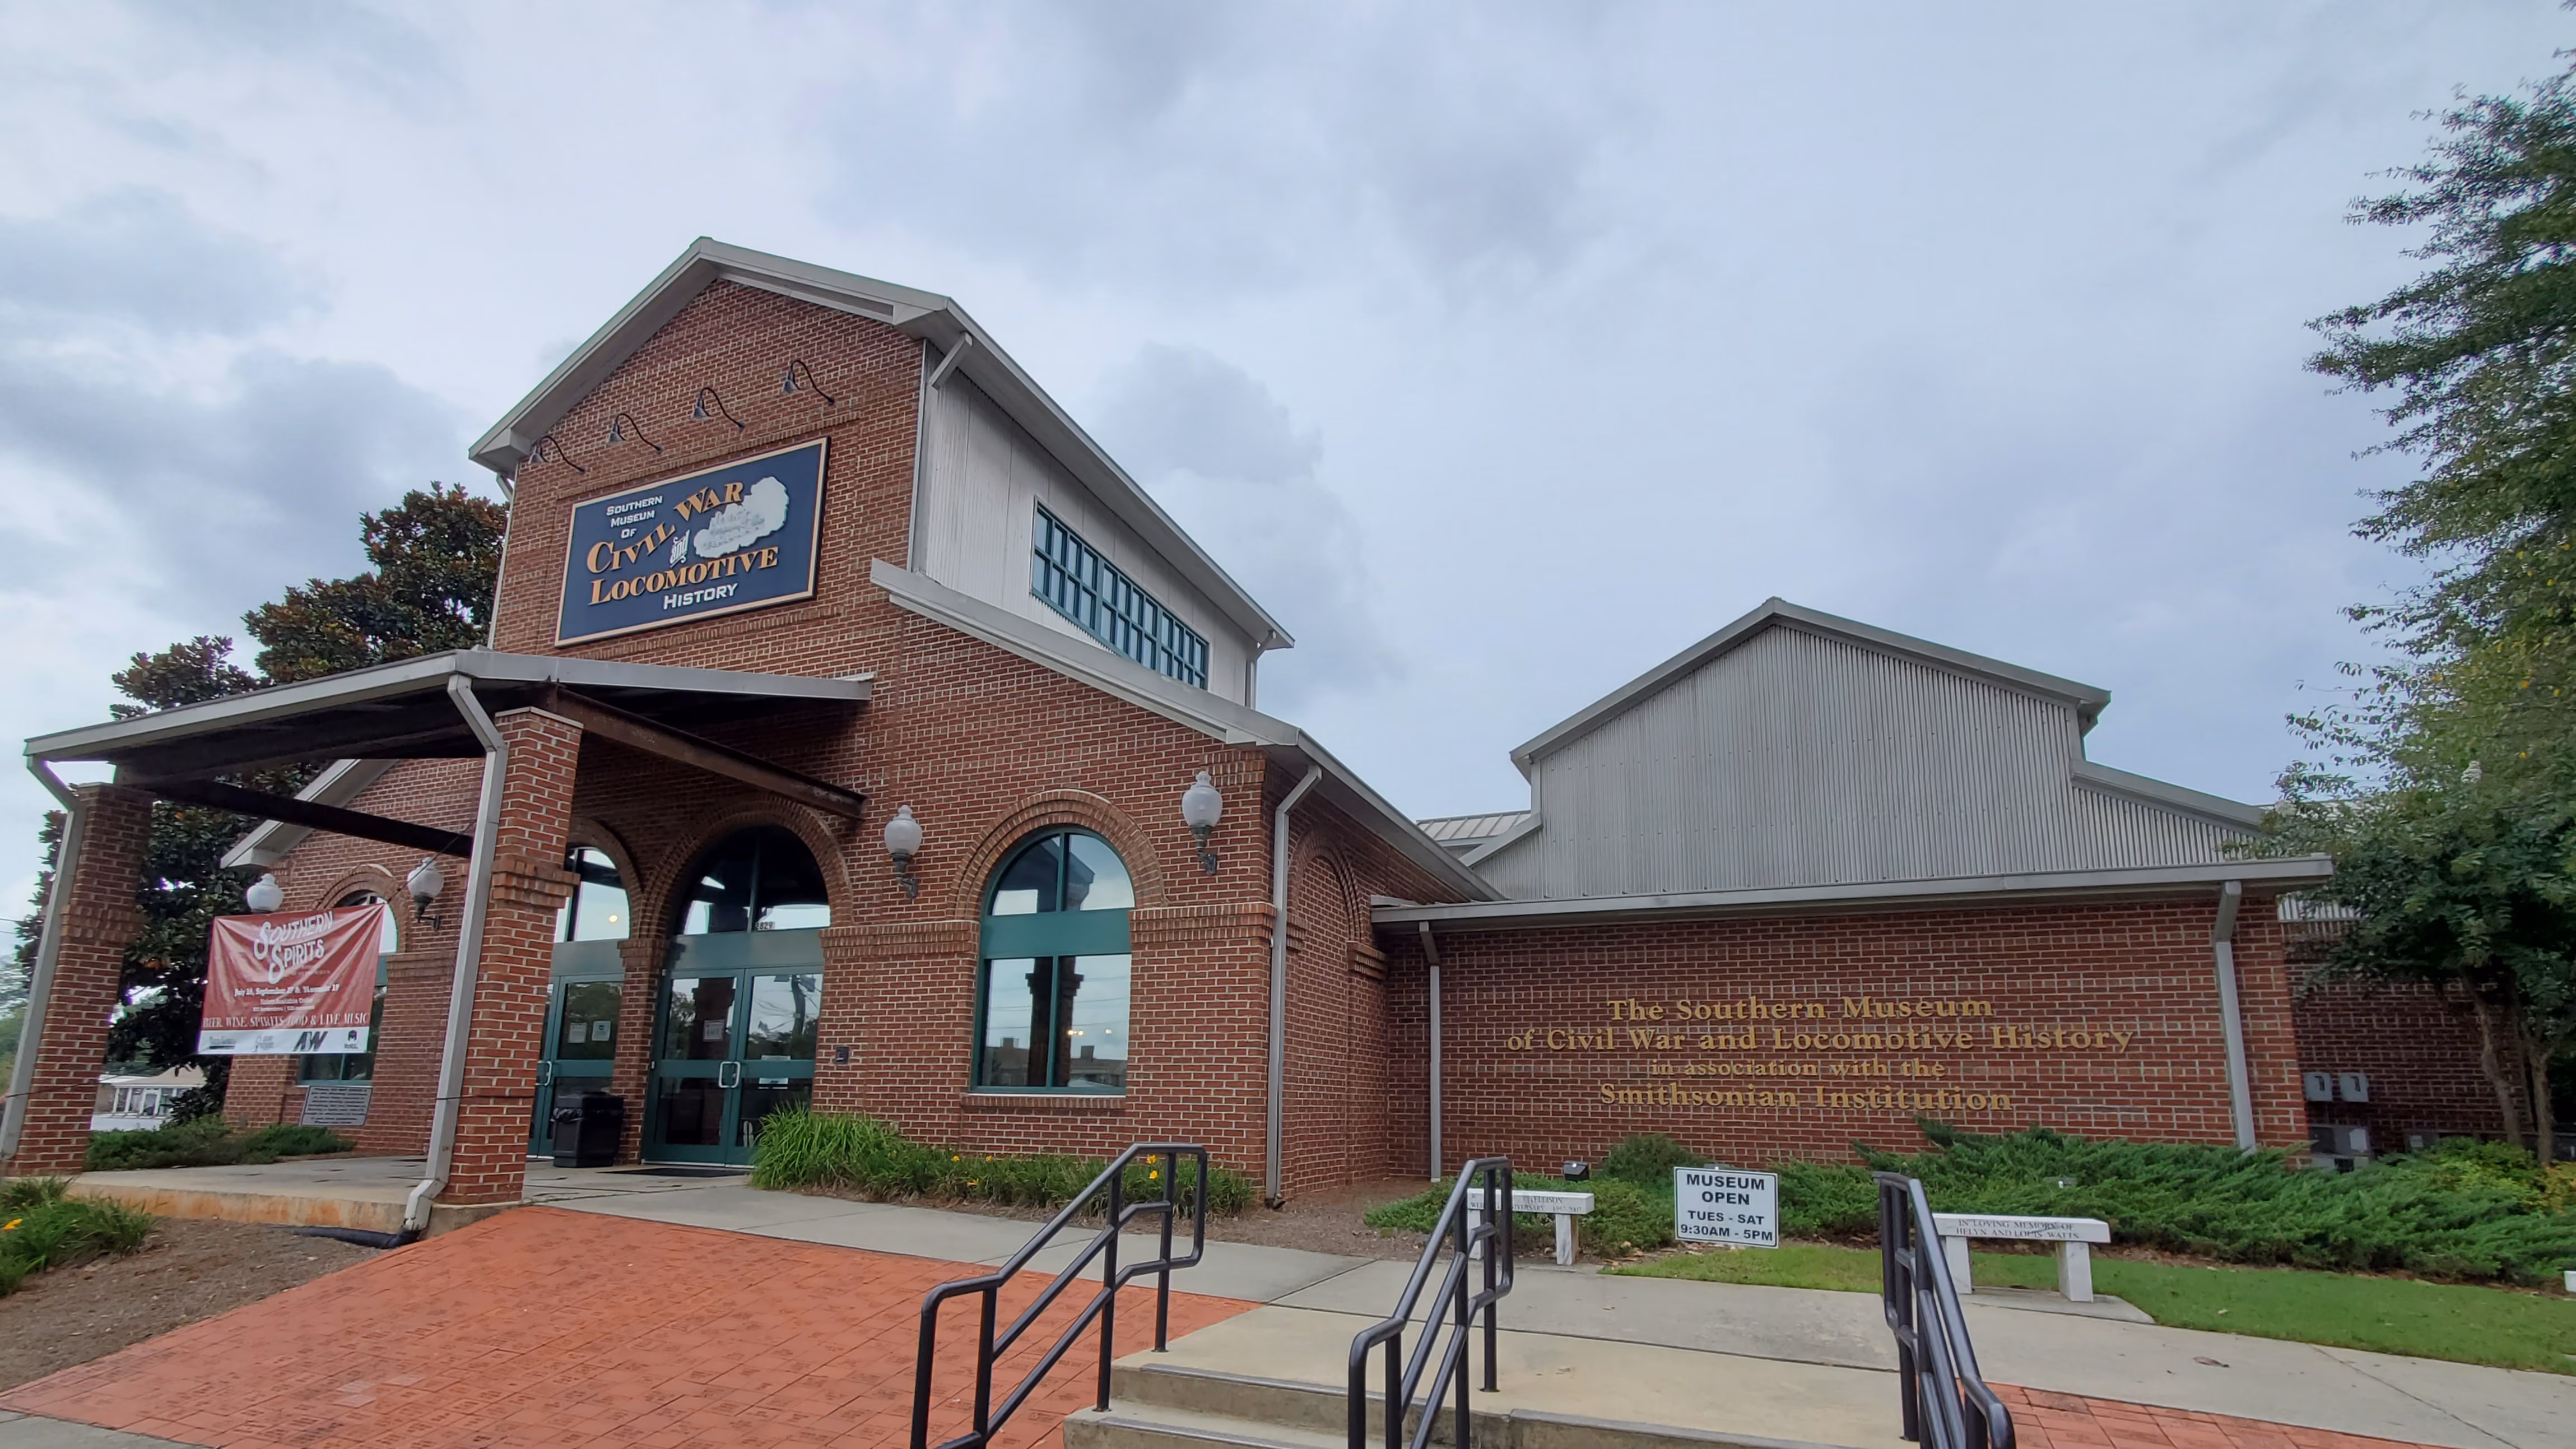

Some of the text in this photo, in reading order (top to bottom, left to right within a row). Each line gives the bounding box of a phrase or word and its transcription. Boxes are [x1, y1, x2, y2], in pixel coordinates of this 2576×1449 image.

[606, 495, 663, 515] SOUTHERN
[587, 481, 745, 574] CIVIL WAR
[611, 509, 655, 528] MUSEUM
[669, 530, 691, 568] and
[588, 546, 779, 606] LOCOMOTIVE
[663, 583, 738, 610] HISTORY
[254, 911, 334, 960] SOUTHERN
[268, 939, 326, 984] SPIRITS
[320, 1014, 341, 1025] LIVE
[345, 1013, 369, 1024] MUSIC
[1607, 996, 1994, 1021] The Southern Museum
[1506, 1025, 2133, 1054] of Civil War and Locomotive History
[1652, 1057, 1946, 1078] in association with the
[1601, 1082, 2013, 1111] Smithsonian Institution
[1686, 1173, 1765, 1191] MUSEUM
[1701, 1191, 1750, 1205] OPEN
[1687, 1210, 1725, 1222] TUES
[1737, 1214, 1764, 1225] SAT
[2014, 1222, 2057, 1230] MEMORY
[1680, 1224, 1730, 1237] 9:30AM
[1743, 1229, 1774, 1242] 5PM
